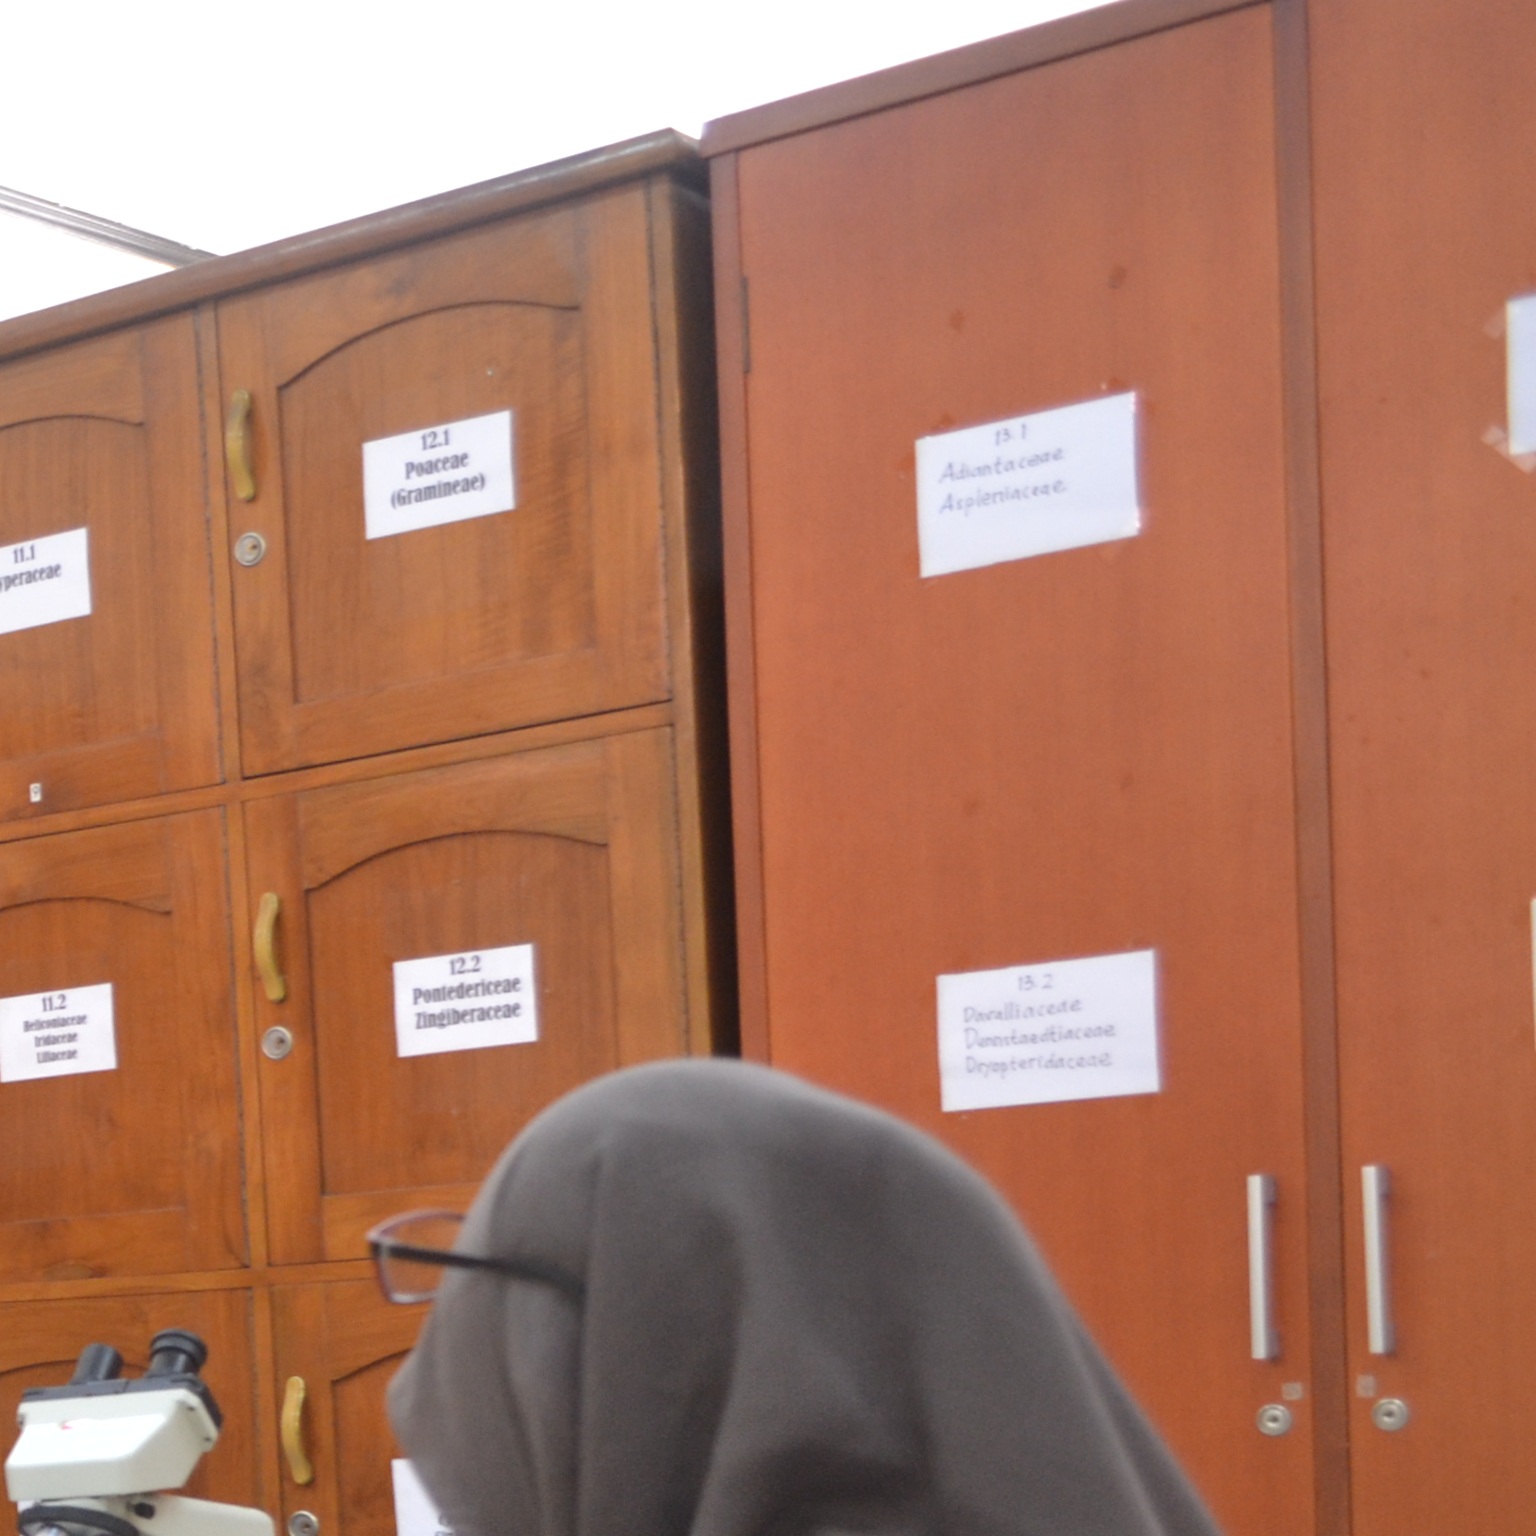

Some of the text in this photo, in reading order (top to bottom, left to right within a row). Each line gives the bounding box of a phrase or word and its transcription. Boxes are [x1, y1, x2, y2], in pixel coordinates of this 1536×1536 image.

[420, 429, 450, 450] 12.1
[404, 451, 469, 479] Poaceae
[390, 473, 486, 509] (Gramineae)
[13, 545, 35, 564] 11.1
[449, 955, 481, 976] 12.2
[41, 994, 67, 1012] 11.2
[415, 1002, 521, 1030] Zingiberaceae
